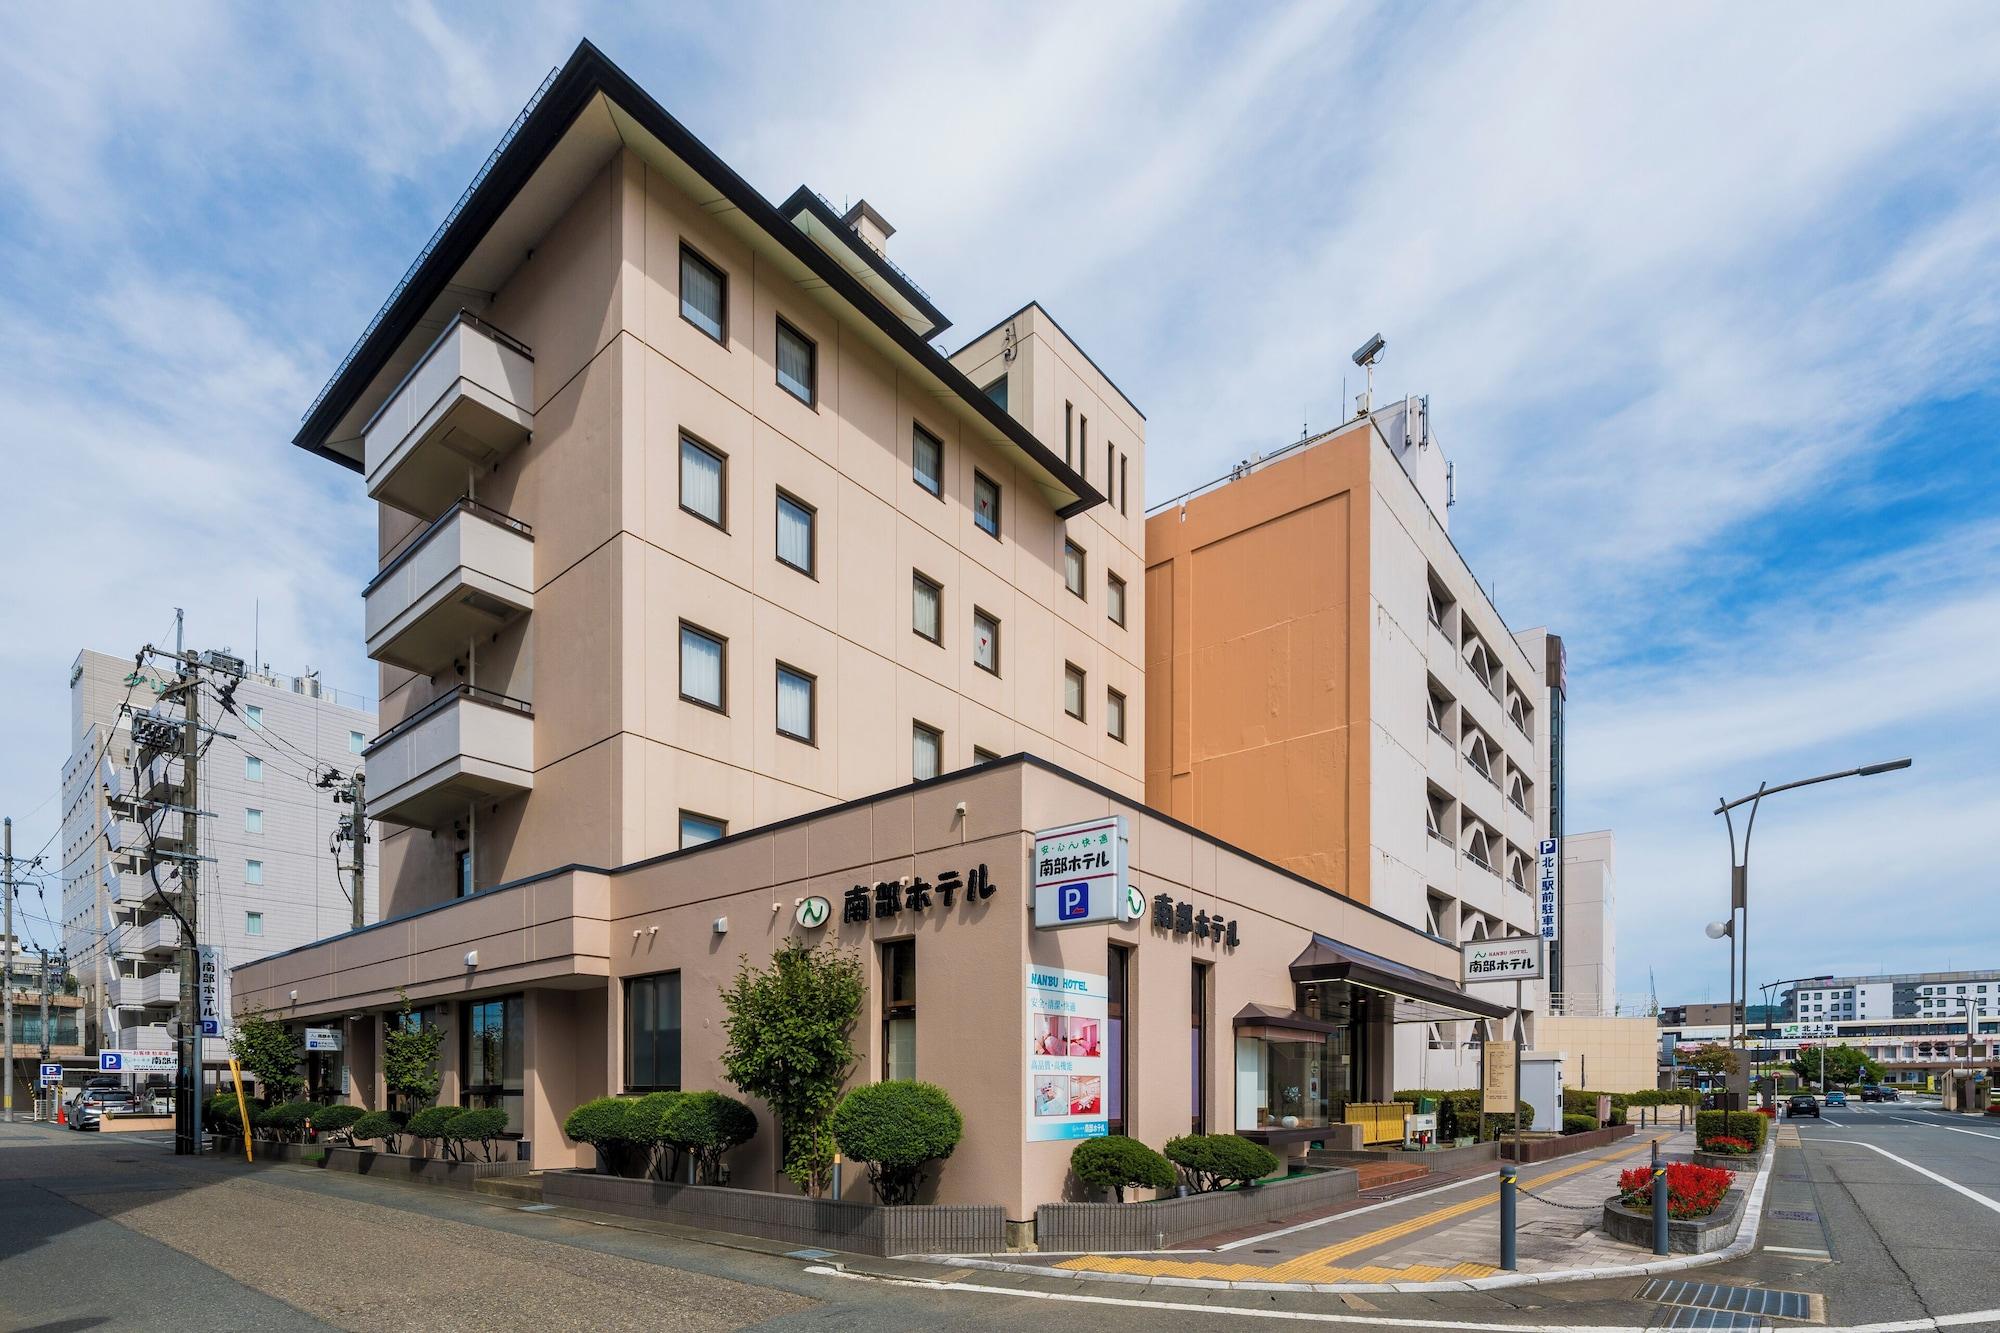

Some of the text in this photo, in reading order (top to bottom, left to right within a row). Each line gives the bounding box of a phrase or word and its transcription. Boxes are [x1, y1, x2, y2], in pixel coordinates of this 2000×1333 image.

[1543, 841, 1553, 854] P
[1039, 850, 1110, 878] 南部ホテル
[843, 863, 998, 924] 南部ホテル
[1065, 888, 1081, 916] P
[1542, 857, 1554, 938] 北上駅前駐車場
[1153, 892, 1241, 948] 南部ホテル
[1469, 957, 1535, 973] 南部ホテル
[202, 961, 216, 1017] 南部ホテル
[1031, 972, 1088, 992] NANBU HOTEL
[203, 1021, 214, 1032] P
[1785, 1025, 1798, 1033] JR
[46, 1066, 57, 1075] P
[105, 1055, 117, 1069] P
